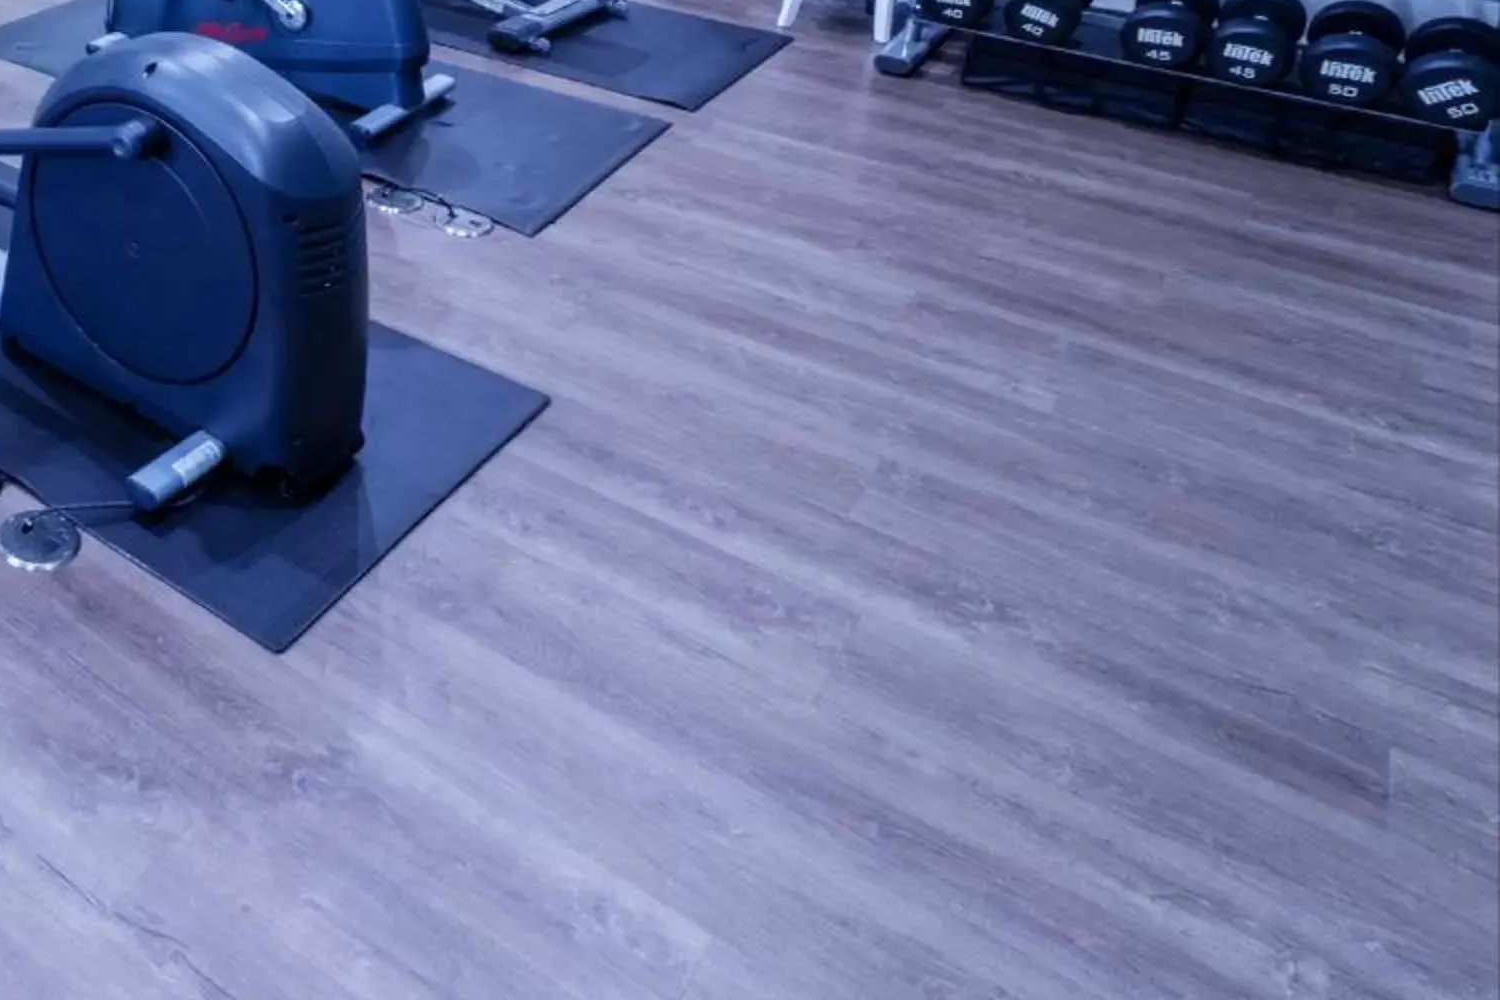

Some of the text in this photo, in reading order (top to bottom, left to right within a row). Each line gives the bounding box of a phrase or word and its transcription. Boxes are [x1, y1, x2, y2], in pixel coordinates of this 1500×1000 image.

[941, 8, 963, 19] 40
[1021, 23, 1044, 37] 40
[1137, 26, 1186, 48] InTek
[1145, 49, 1172, 61] 45
[1223, 43, 1275, 67] InTek
[1319, 59, 1378, 84] InTek
[1327, 83, 1359, 98] 50
[1417, 78, 1481, 105] InTek
[1446, 103, 1480, 119] 50
